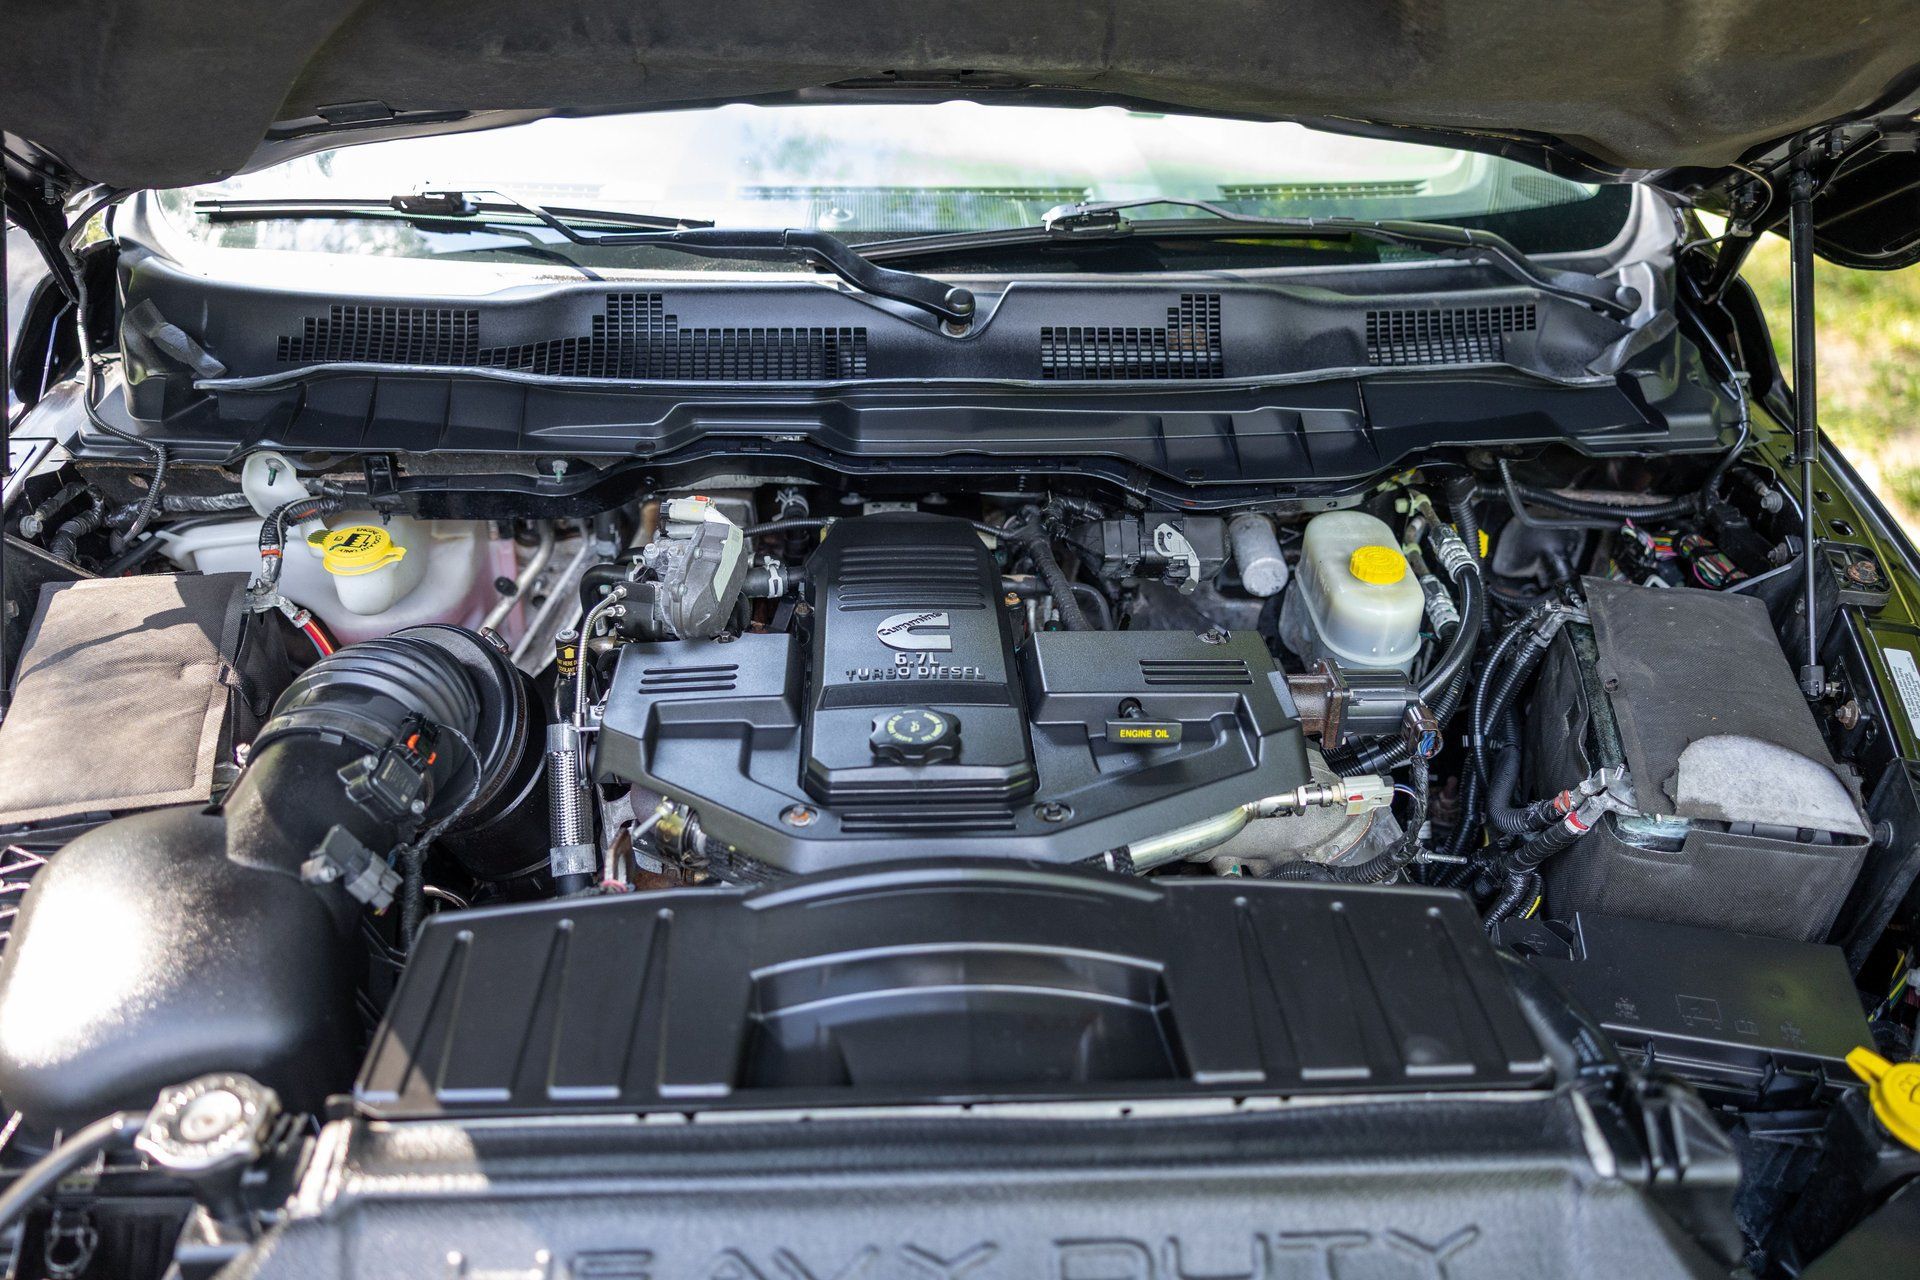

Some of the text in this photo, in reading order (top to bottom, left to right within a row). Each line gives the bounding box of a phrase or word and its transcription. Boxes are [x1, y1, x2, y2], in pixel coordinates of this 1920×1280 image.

[877, 611, 943, 636] Cummins
[894, 651, 940, 667] 6.7L
[845, 666, 986, 680] TURBO DIESEL
[1119, 728, 1170, 739] ENGINE OIL
[1052, 1223, 1482, 1280] DUTY
